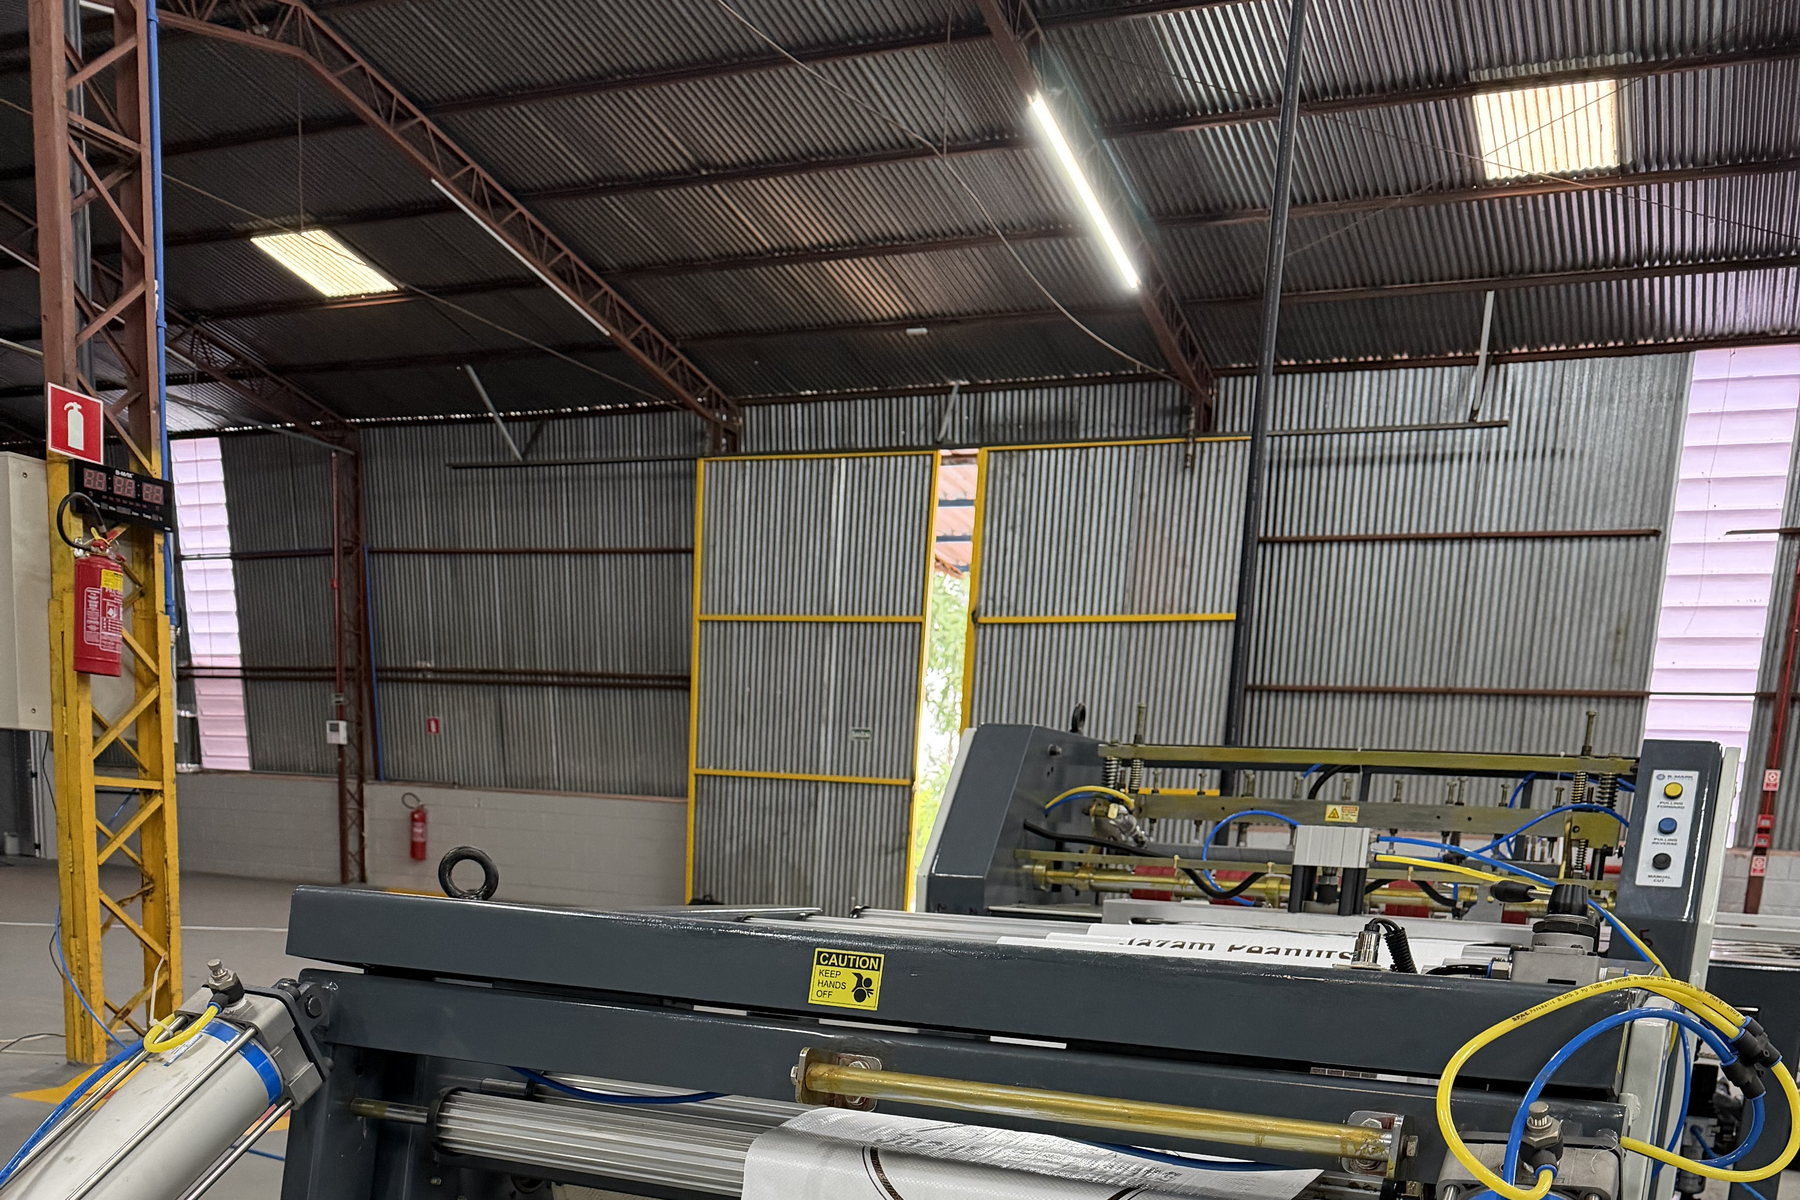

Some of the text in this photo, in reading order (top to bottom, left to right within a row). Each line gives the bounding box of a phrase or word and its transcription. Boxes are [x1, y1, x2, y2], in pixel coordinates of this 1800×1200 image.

[819, 953, 879, 970] CAUTION
[818, 969, 841, 979] KEEP
[817, 980, 847, 990] HANDS
[816, 990, 833, 998] OFF
